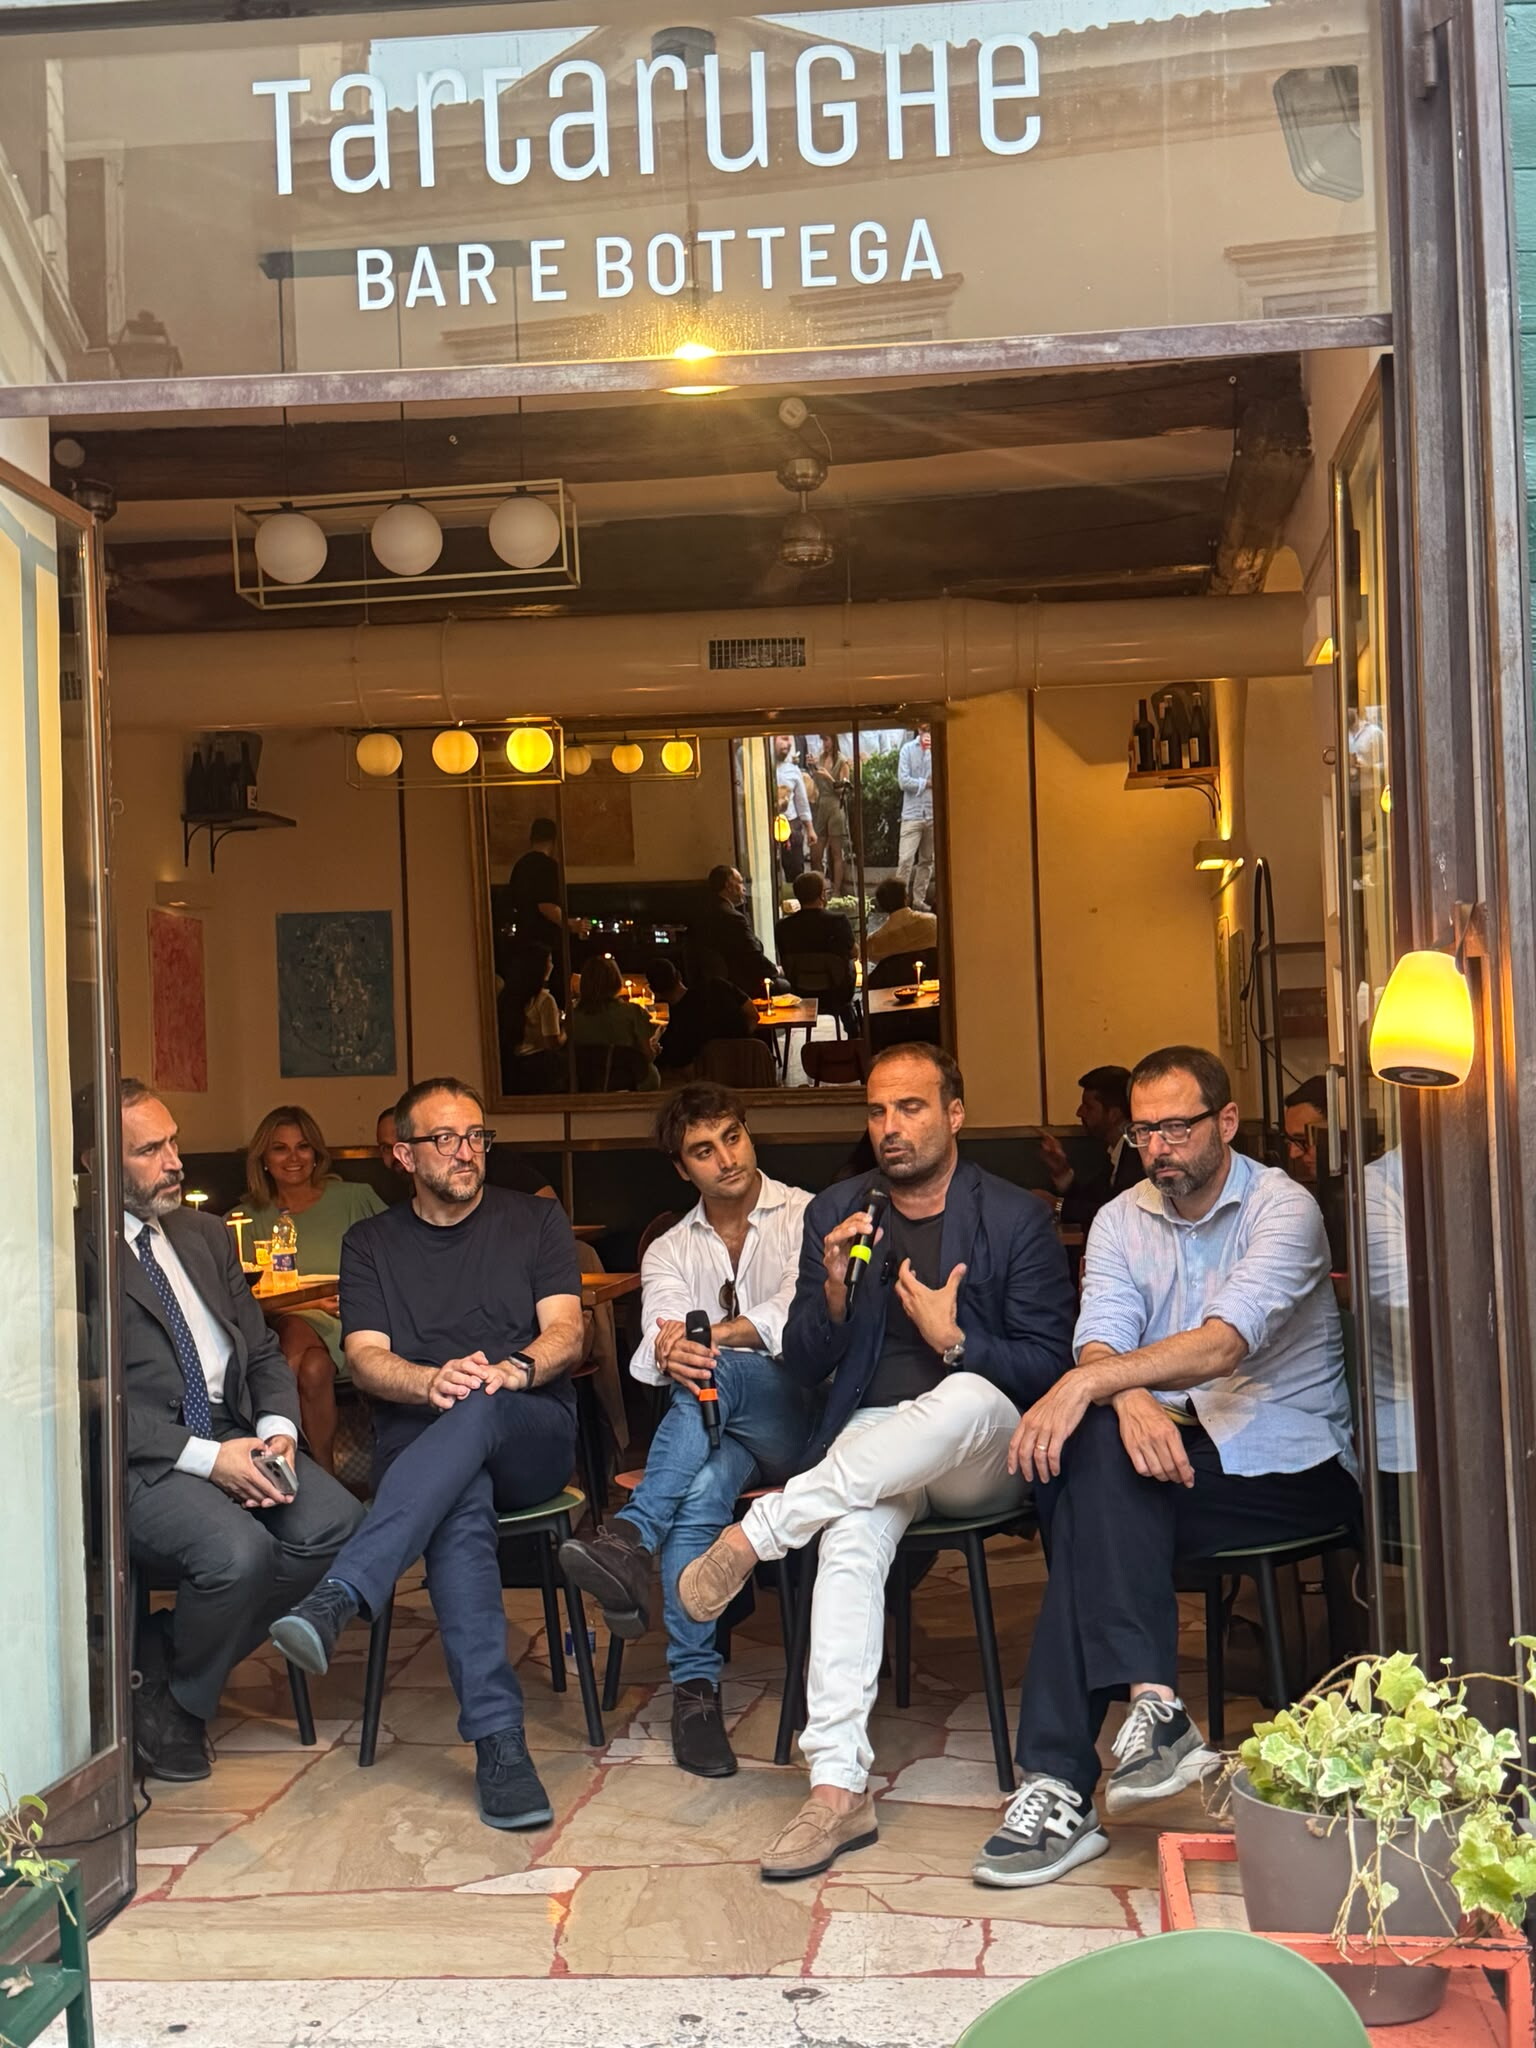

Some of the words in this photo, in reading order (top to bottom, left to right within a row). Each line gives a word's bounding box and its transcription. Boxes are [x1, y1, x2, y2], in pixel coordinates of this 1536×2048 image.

[356, 243, 497, 312] BAR
[531, 239, 567, 303] E
[595, 218, 944, 299] BOTTEGA
